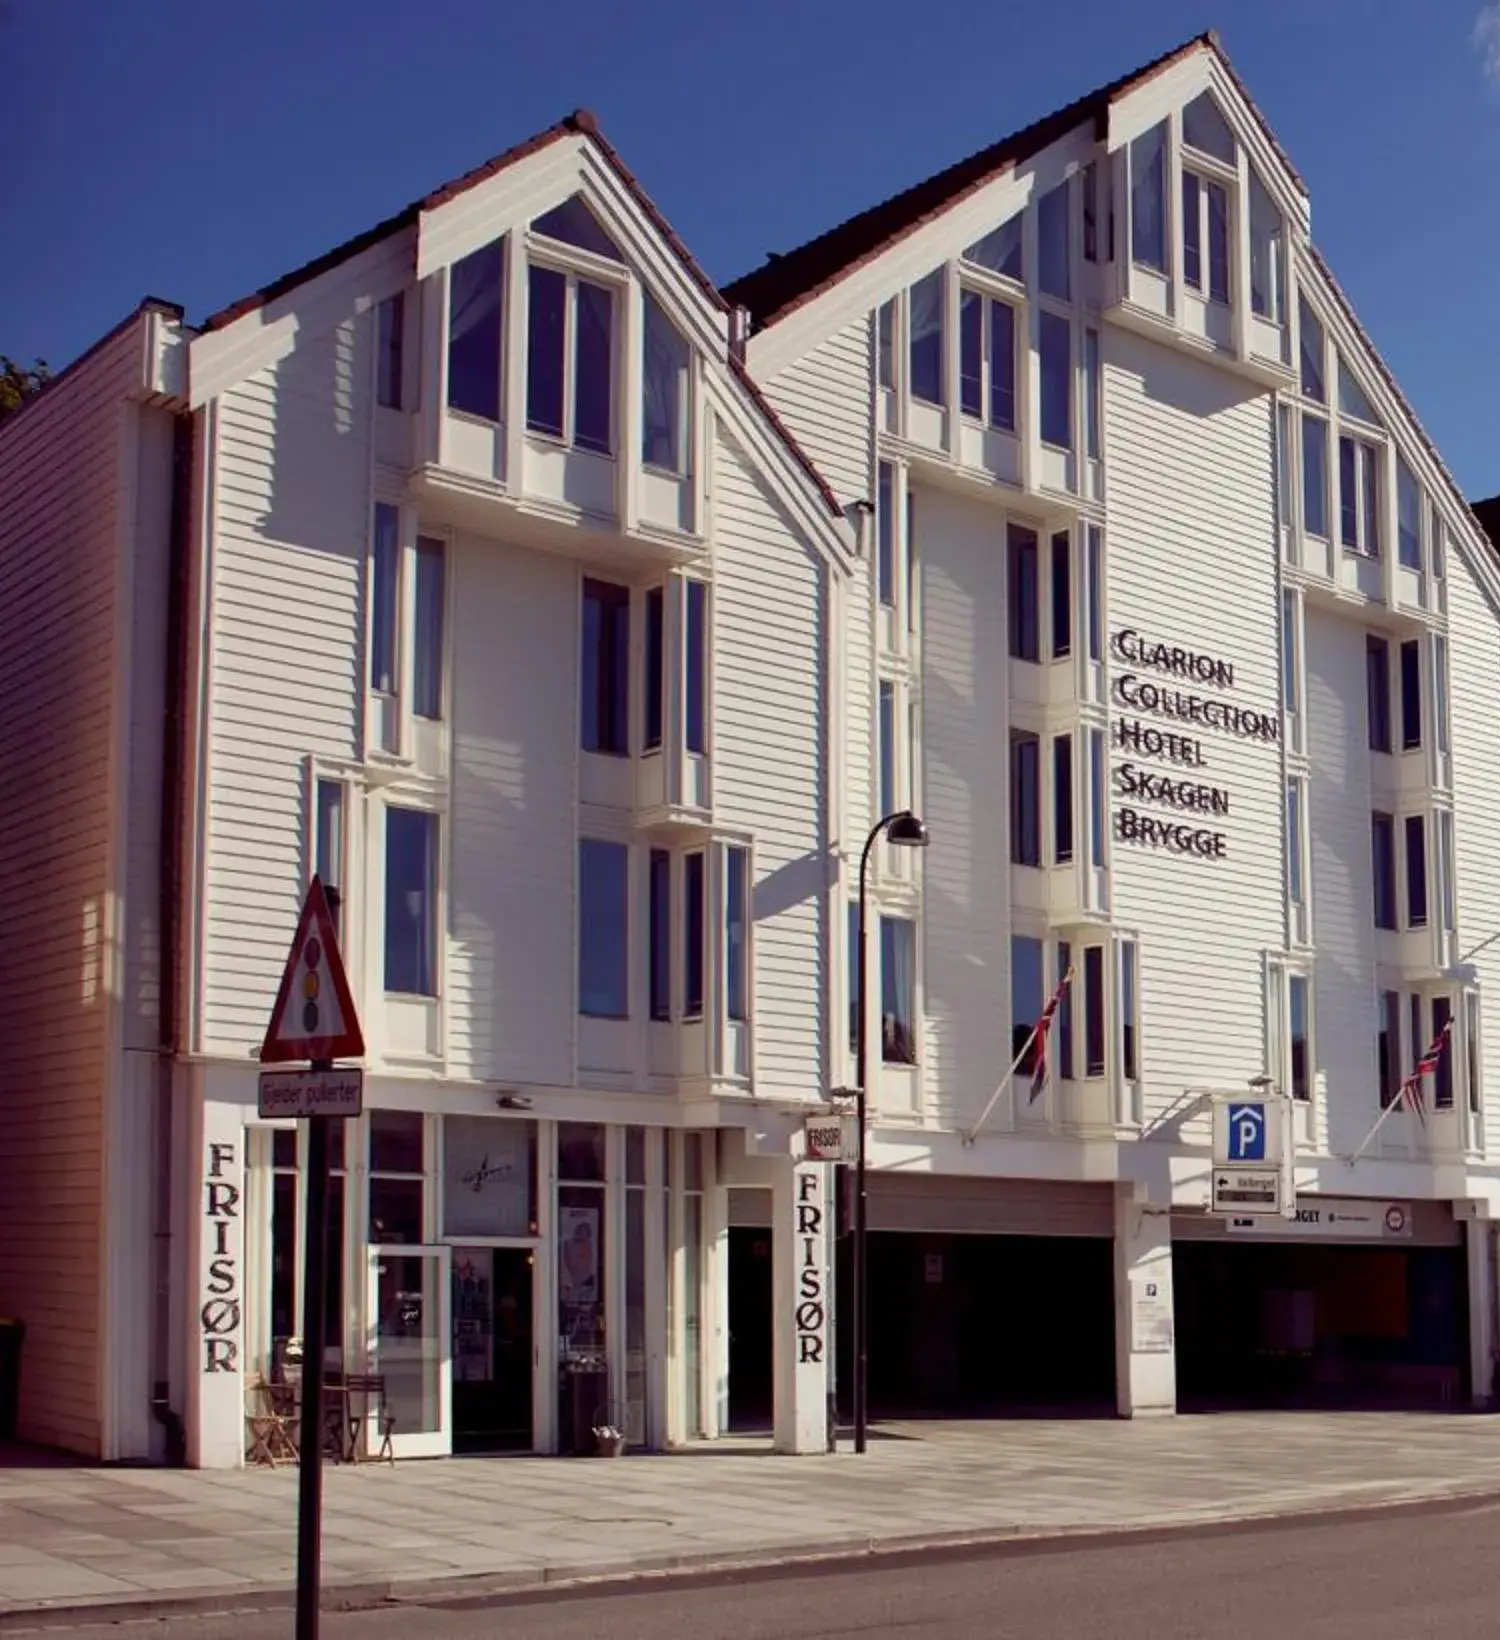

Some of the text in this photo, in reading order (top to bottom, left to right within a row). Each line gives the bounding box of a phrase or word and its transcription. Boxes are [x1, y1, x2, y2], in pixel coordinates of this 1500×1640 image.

[1117, 629, 1234, 686] CLARION
[1118, 674, 1279, 740] COLLECTION
[1119, 717, 1207, 767] HOTEL
[1119, 763, 1229, 815] SKAGEN
[1119, 808, 1227, 858] BRYGGE
[1239, 1121, 1257, 1157] P
[201, 1143, 241, 1374] FRISØR
[795, 1173, 825, 1364] FRISØR
